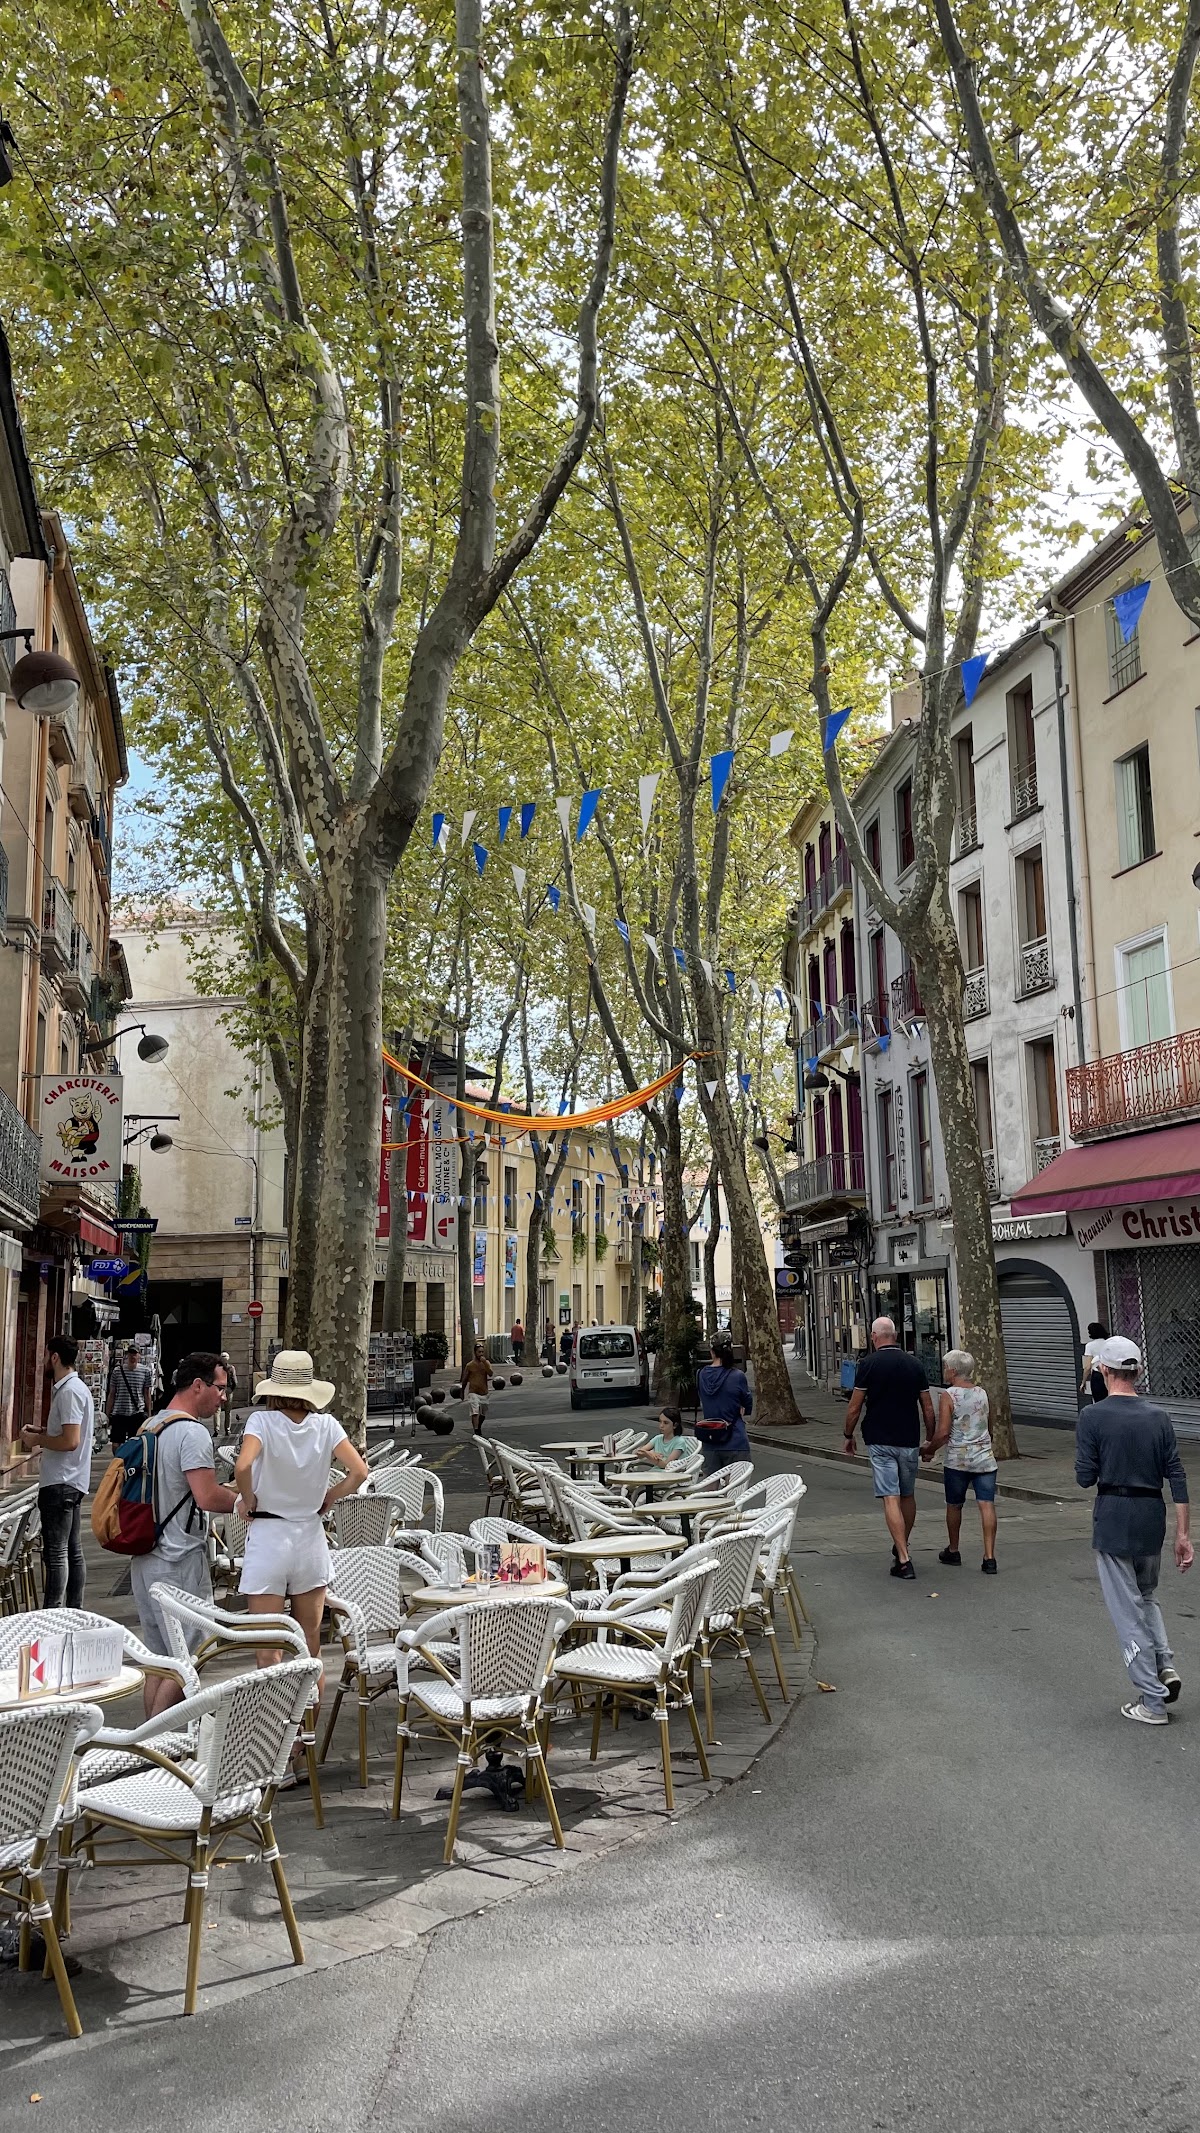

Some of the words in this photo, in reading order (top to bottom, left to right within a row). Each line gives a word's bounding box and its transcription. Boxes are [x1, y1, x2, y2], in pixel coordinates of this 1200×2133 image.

[44, 1078, 120, 1105] CHARCUTERIE
[49, 1159, 110, 1178] MAISON
[1077, 1209, 1114, 1248] Chausseur
